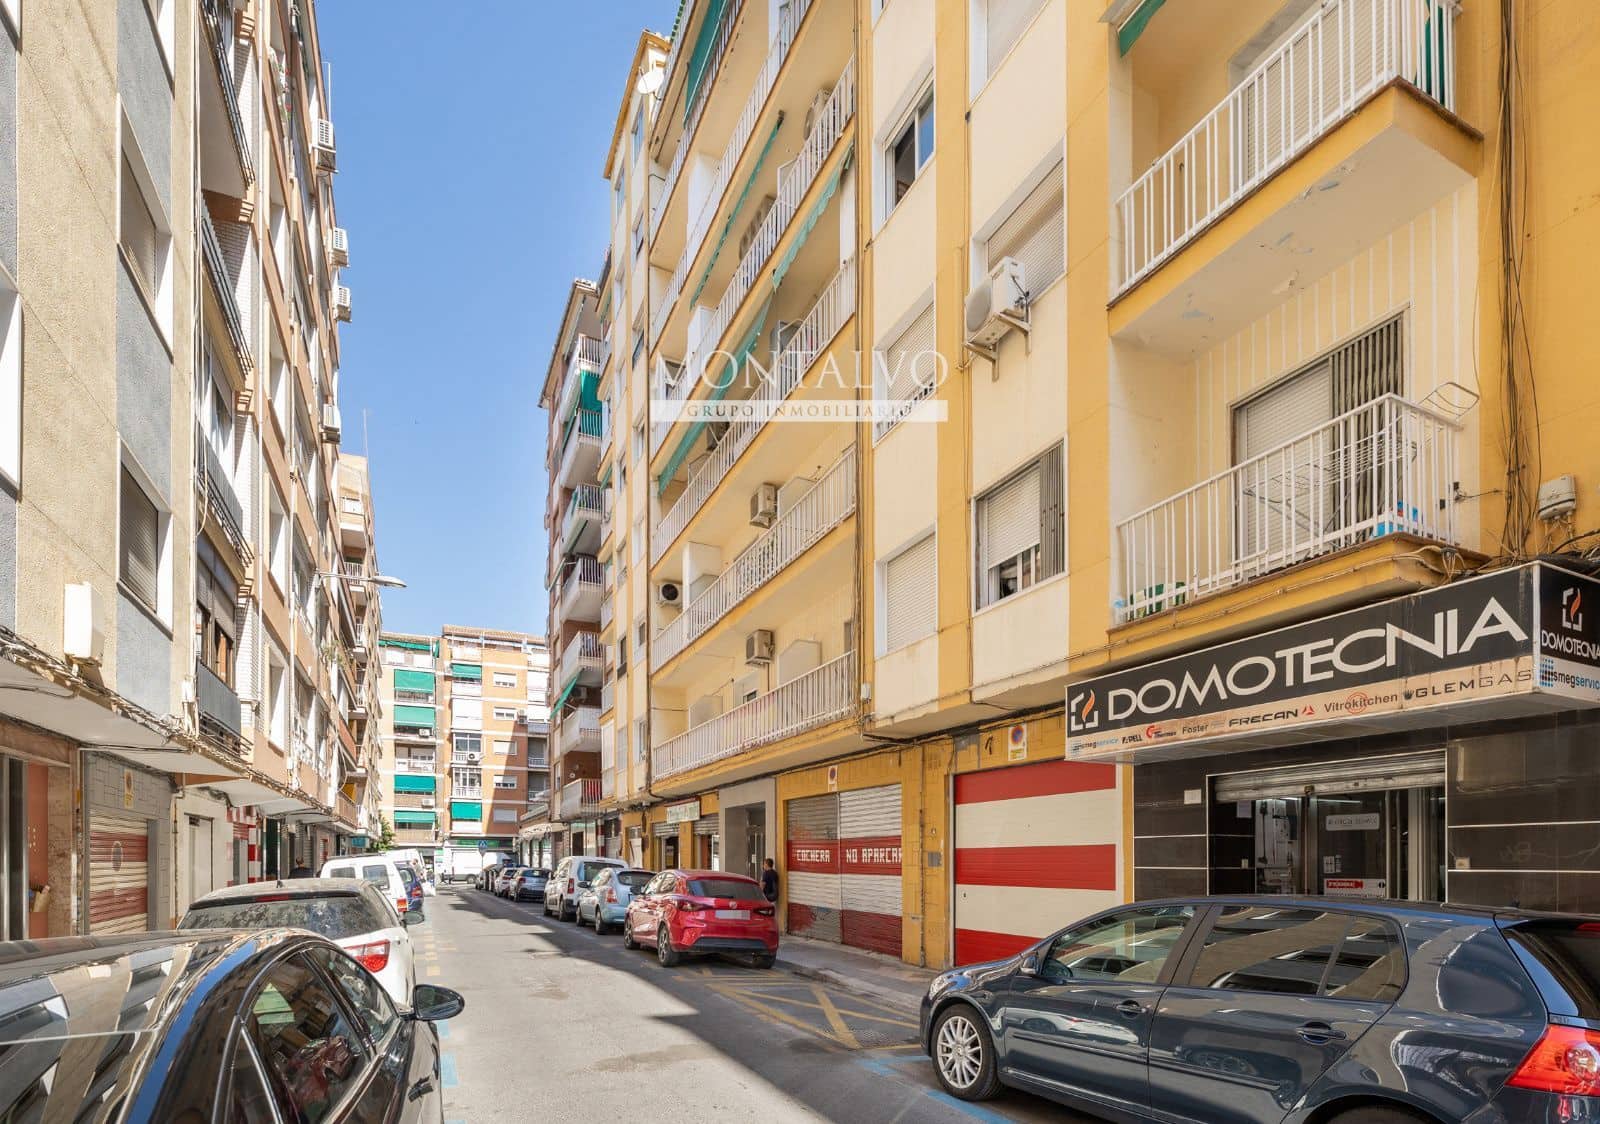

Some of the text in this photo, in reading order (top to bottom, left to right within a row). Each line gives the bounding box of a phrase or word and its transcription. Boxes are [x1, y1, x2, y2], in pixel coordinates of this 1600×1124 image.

[1107, 596, 1529, 721] DOMOTECNIA
[1415, 669, 1532, 698] GLEMGAS
[1553, 671, 1600, 690] smegservic
[1324, 693, 1398, 713] Vitrokitchen
[1228, 708, 1299, 728] FRECAN
[1182, 723, 1209, 734] Foster
[796, 849, 830, 863] COCHERA
[846, 849, 858, 863] NO
